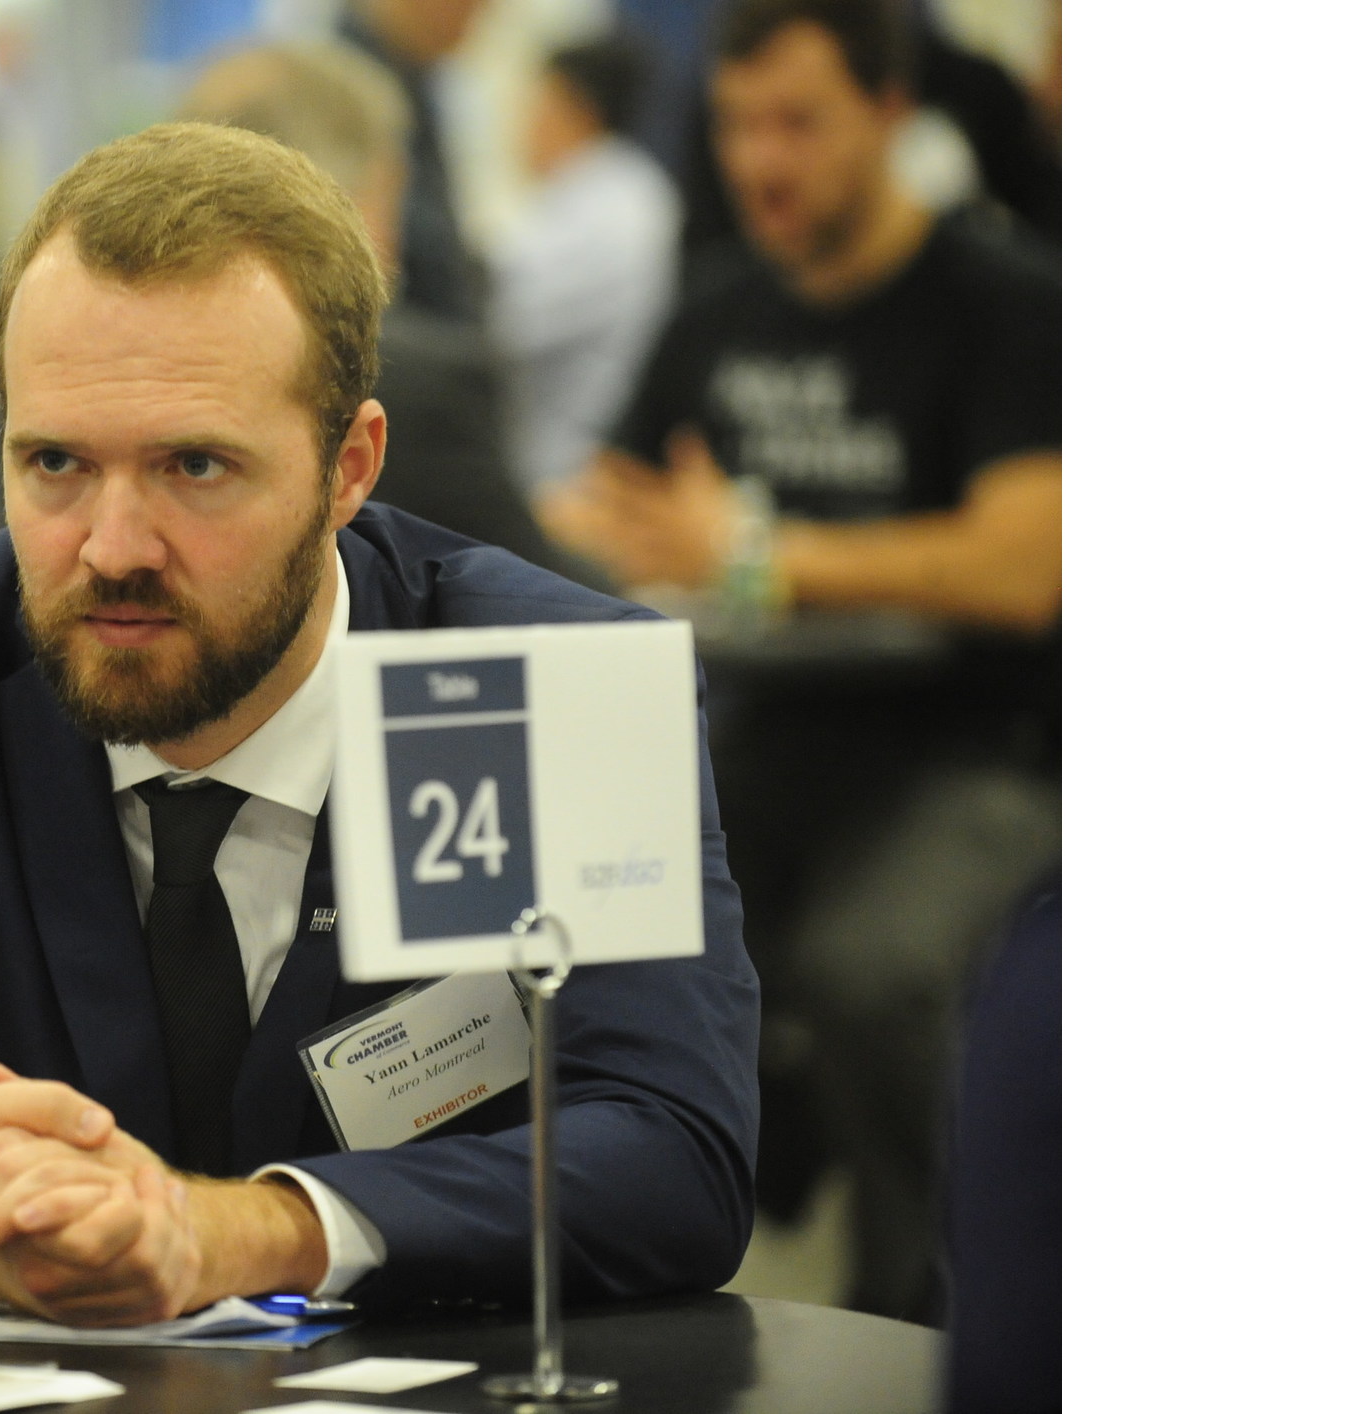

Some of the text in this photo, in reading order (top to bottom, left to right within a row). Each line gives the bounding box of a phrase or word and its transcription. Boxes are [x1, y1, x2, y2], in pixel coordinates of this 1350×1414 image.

[409, 776, 510, 884] 24
[347, 1030, 408, 1065] CHAMBER
[360, 1021, 403, 1047] VERMONT
[364, 1013, 492, 1085] Yann Lamarche
[387, 1037, 486, 1100] Aero Montreal
[413, 1083, 488, 1129] EXHIBITOR
